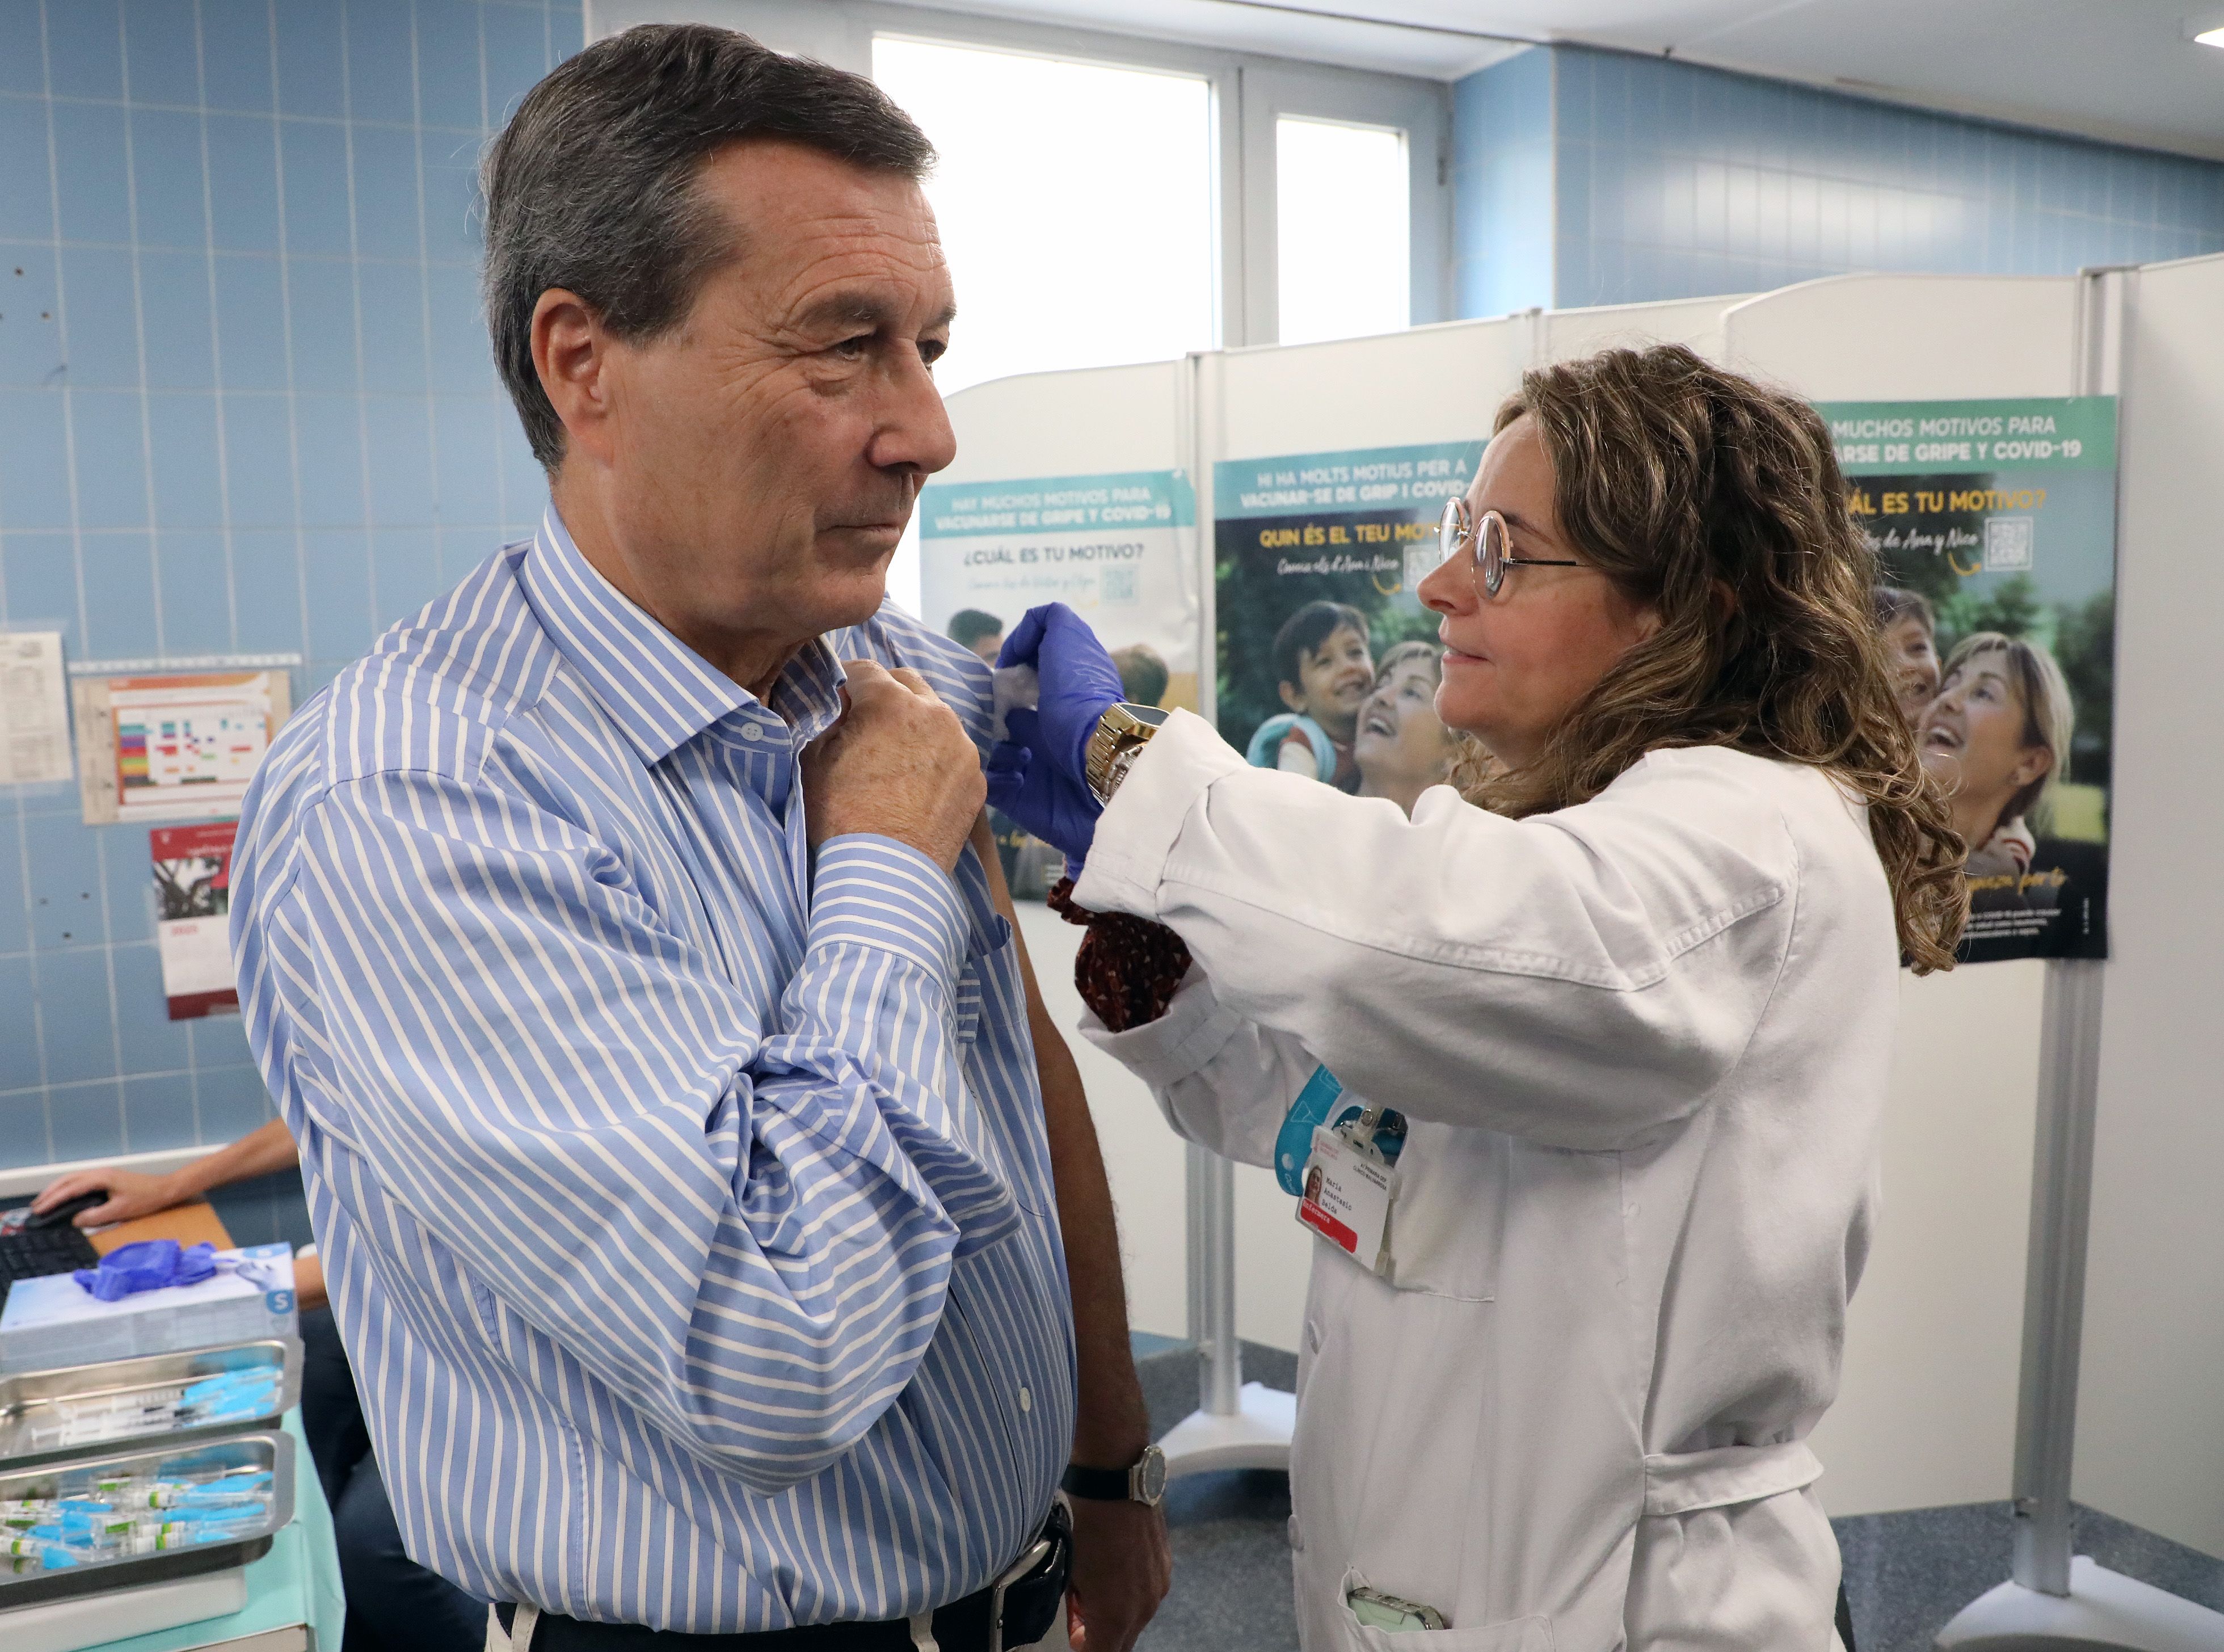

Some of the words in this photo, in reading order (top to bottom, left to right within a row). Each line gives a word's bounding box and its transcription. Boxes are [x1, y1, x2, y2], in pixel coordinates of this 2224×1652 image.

[1831, 419, 1914, 438] MUCHOS
[1919, 416, 2002, 436] MOTIVOS
[2008, 415, 2056, 435] PARA
[1833, 444, 1879, 462] ARSE
[1884, 443, 1910, 462] DE
[1915, 442, 1972, 462] GRIPE
[1977, 441, 1988, 460] Y
[1994, 439, 2082, 460] COVID-19
[1257, 473, 1273, 487] HI
[1276, 471, 1296, 486] HA
[1300, 467, 1350, 484] MOLTS
[1353, 462, 1413, 481] MOTIUS
[1417, 459, 1451, 477] PER
[1455, 458, 1467, 475] A
[981, 492, 1042, 510] MUCHOS
[1044, 488, 1108, 507] MOTIVOS
[1111, 487, 1151, 502] PARA
[1240, 488, 1332, 508] VACUNAR-SE
[1336, 486, 1357, 502] DE
[1359, 483, 1398, 500] GRIP
[1401, 482, 1408, 499] I
[1412, 479, 1470, 498] COVID-
[1848, 486, 1877, 515] ÁL
[1882, 491, 1910, 515] ES
[1915, 490, 1944, 513] TU
[1949, 488, 2046, 511] MOTIVO?
[936, 512, 1016, 530] VACUNARSE
[1019, 511, 1037, 526] DE
[1041, 509, 1084, 526] GRIPE
[1088, 508, 1098, 523] Y
[1101, 502, 1172, 522] COVID-19
[1260, 527, 1300, 549] QUIN
[1304, 522, 1326, 546] ÉS
[1329, 525, 1351, 545] EL
[1355, 524, 1390, 543] TEU
[1394, 522, 1440, 541] MOT
[964, 545, 1014, 567] ¿CUÁL
[1020, 546, 1039, 563] ES
[1043, 545, 1064, 562] TU
[1069, 543, 1144, 562] MOTIVO?
[274, 1292, 289, 1310] S
